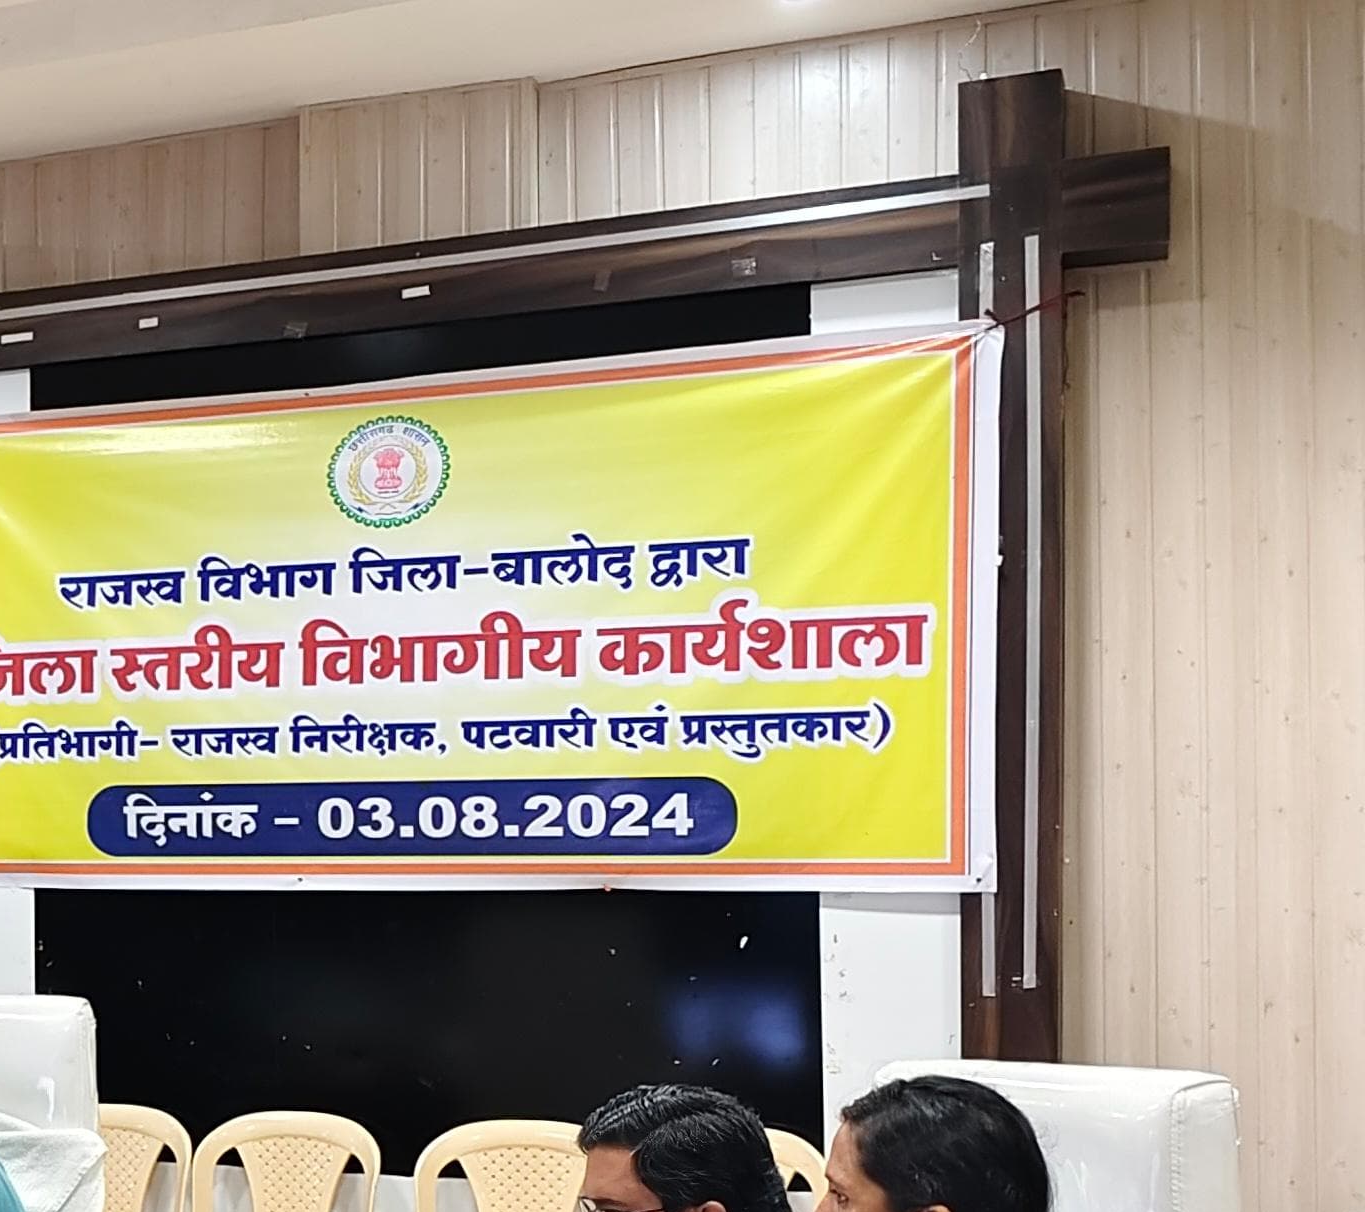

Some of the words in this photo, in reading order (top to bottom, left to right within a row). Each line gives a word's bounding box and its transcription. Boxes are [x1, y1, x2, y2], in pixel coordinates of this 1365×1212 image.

[60, 571, 185, 608] राजस्व
[197, 557, 336, 601] विभाग
[349, 534, 634, 593] जिला-बालोद
[649, 539, 749, 586] द्वारा
[111, 624, 284, 692] स्तरीय
[299, 612, 581, 686] विभागीय
[597, 599, 927, 675] कार्यशाला
[171, 727, 279, 756] राजस्व
[290, 715, 447, 755] निरीक्षक,
[461, 708, 596, 749] पटवारी
[609, 705, 668, 748] एवं
[680, 704, 891, 758] प्रस्तुतकार)
[124, 792, 257, 845] दिनांक
[318, 793, 694, 839] 03.08.2024
